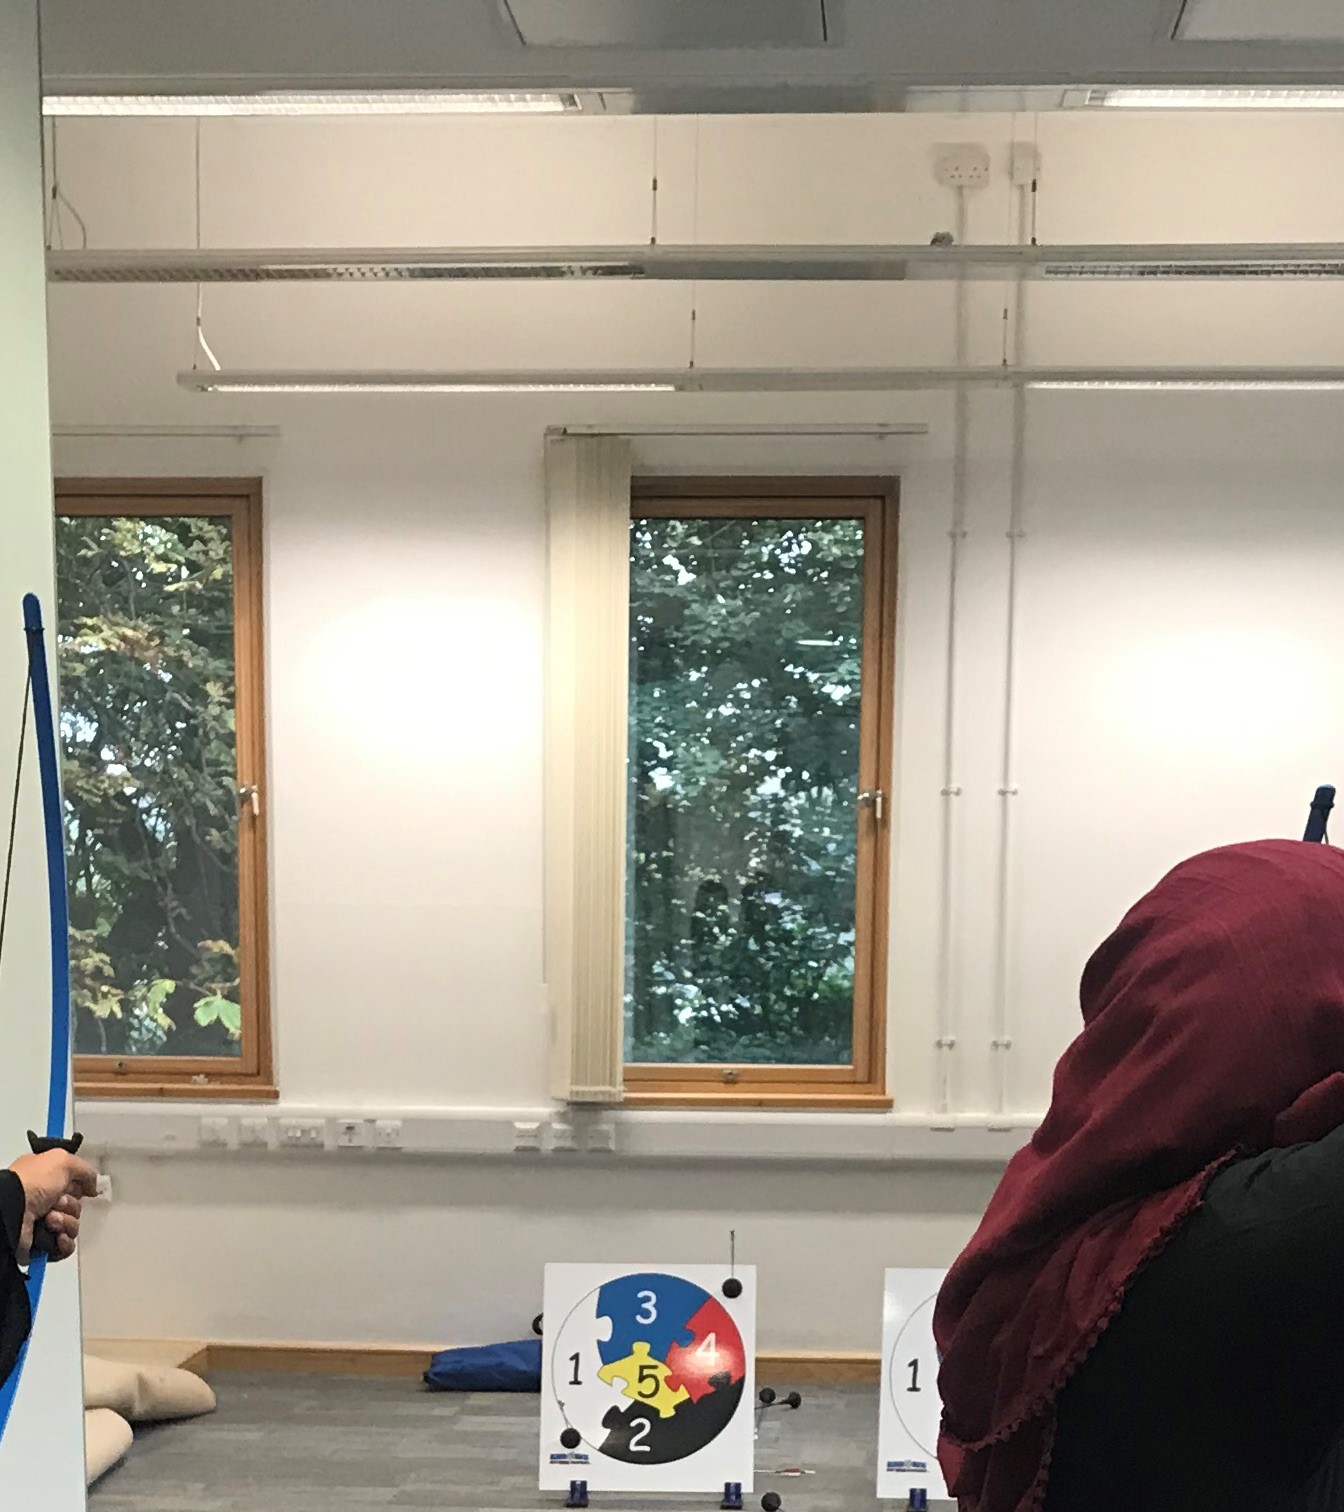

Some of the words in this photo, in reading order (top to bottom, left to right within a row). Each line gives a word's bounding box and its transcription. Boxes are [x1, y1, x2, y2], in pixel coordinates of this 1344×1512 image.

[635, 1290, 657, 1325] 3
[696, 1332, 720, 1366] 4
[568, 1352, 583, 1386] 1
[637, 1364, 660, 1399] 5
[907, 1358, 921, 1392] 1
[629, 1417, 651, 1452] 2
